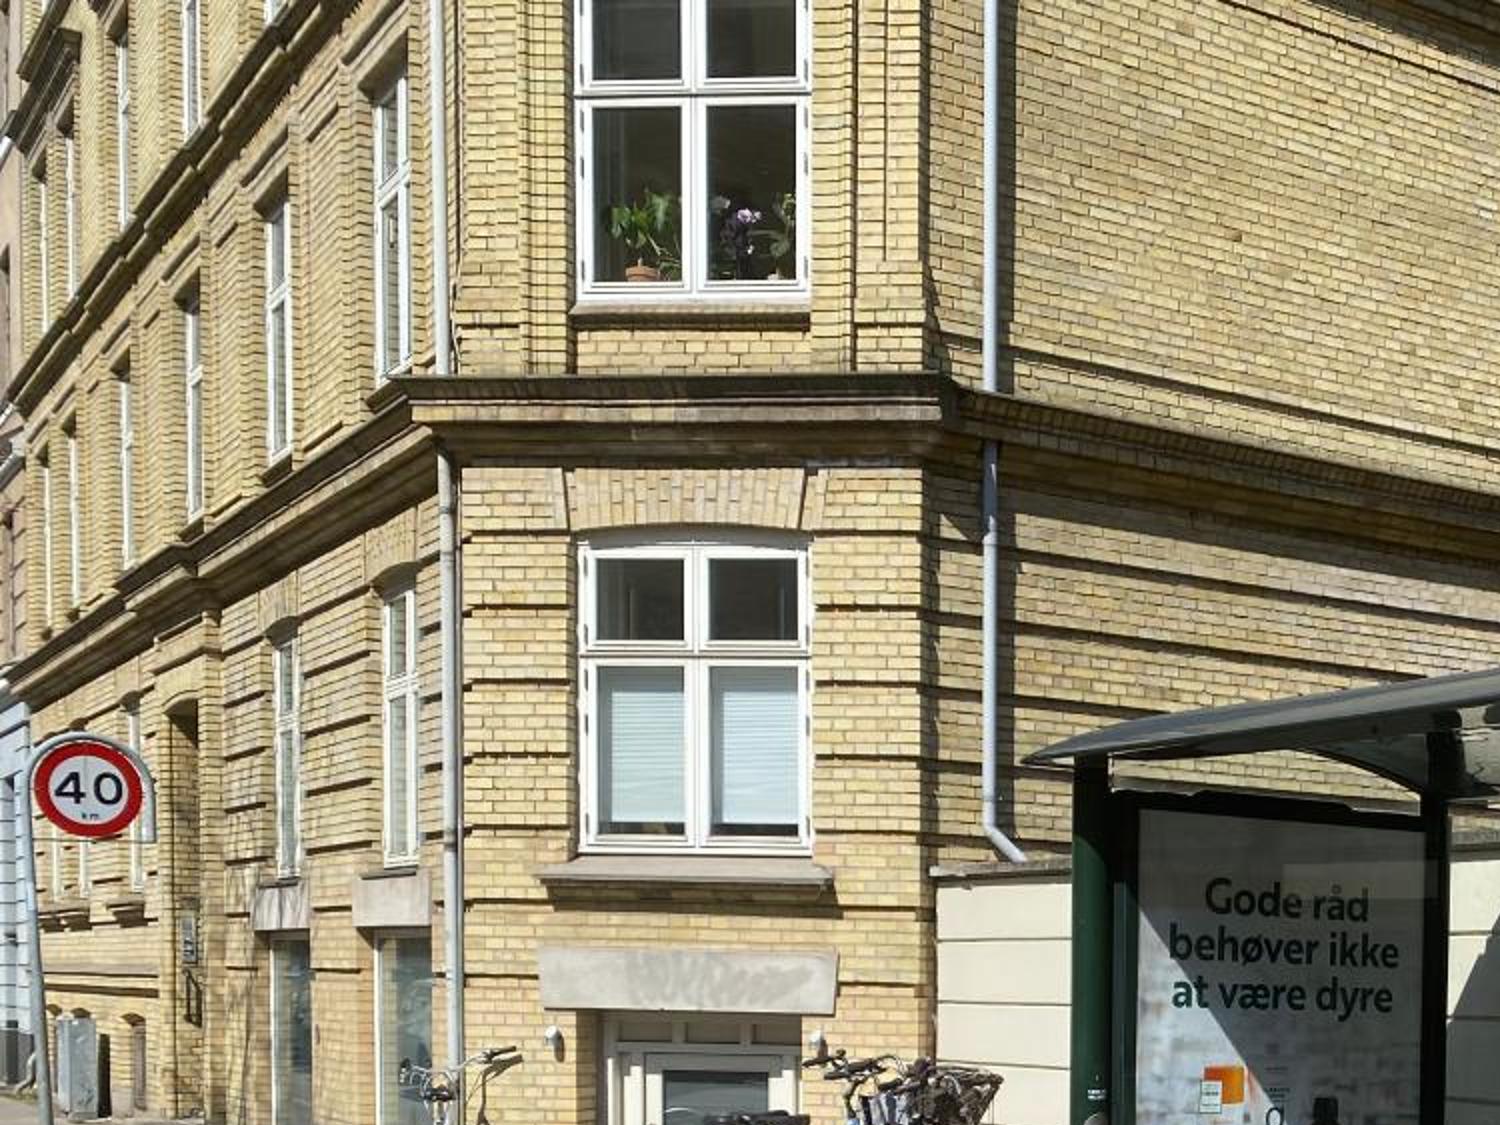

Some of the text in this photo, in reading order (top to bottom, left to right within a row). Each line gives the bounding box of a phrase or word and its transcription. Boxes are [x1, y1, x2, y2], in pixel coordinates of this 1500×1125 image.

[54, 771, 123, 805] 40
[1205, 877, 1369, 922] Gode råd
[1169, 922, 1400, 968] behøver ikke
[1171, 976, 1393, 1021] at være dyre
